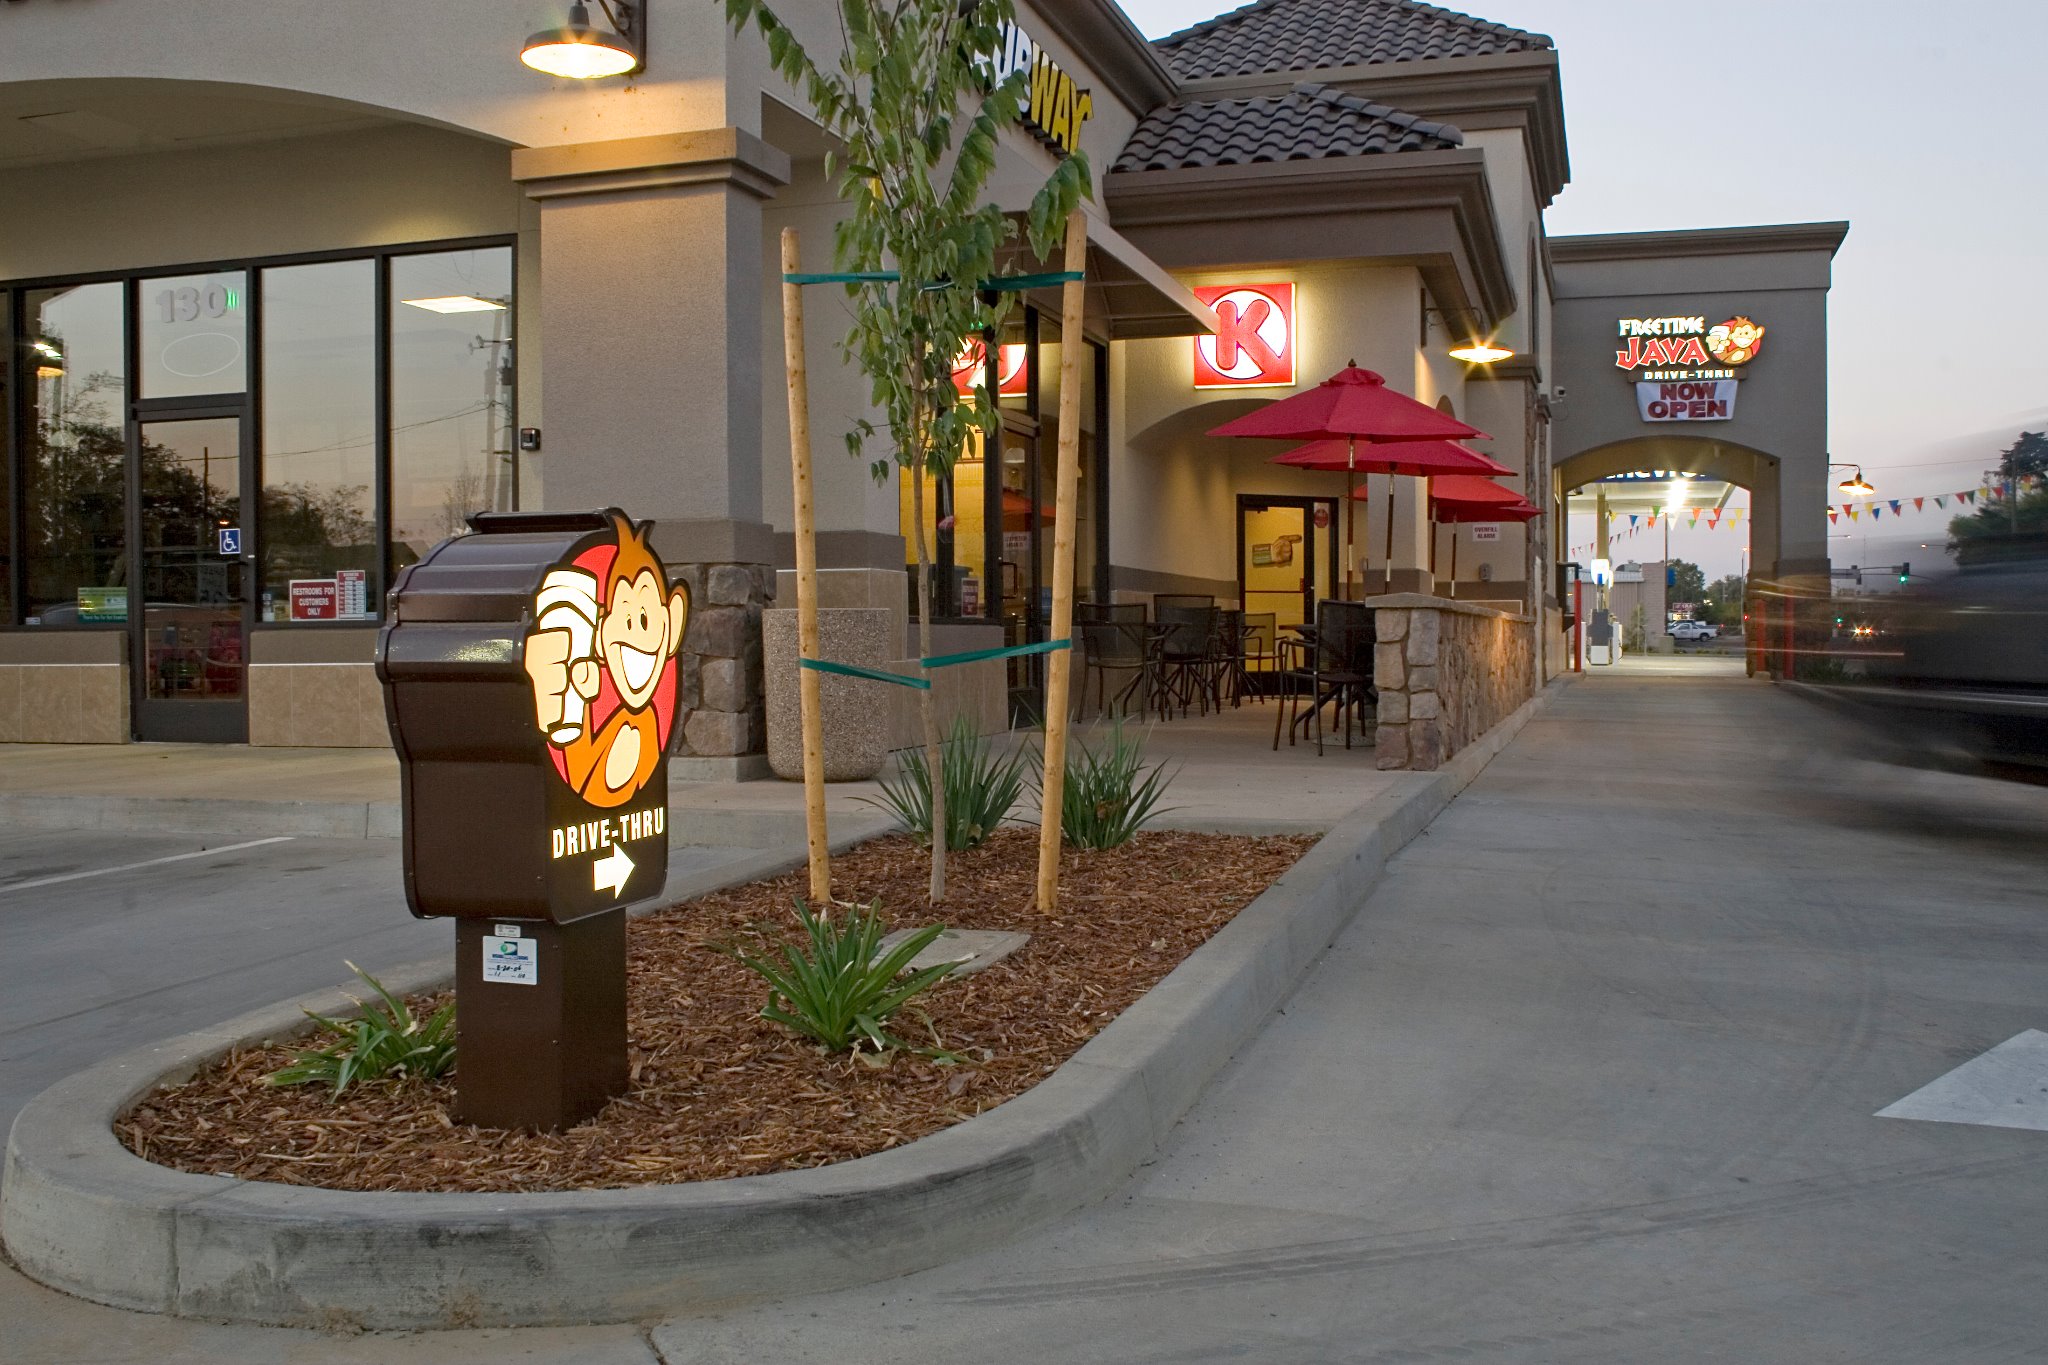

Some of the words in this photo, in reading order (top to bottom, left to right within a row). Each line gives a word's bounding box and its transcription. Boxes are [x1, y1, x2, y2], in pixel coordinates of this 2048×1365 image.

[156, 284, 227, 323] 130
[1618, 316, 1705, 336] FREETIME
[1216, 299, 1281, 372] K
[1615, 336, 1709, 370] JAVA
[1644, 369, 1734, 380] DRIVE-THRU
[1659, 382, 1717, 400] NOW
[1647, 400, 1727, 418] OPEN
[293, 587, 322, 595] RESTROOMS
[324, 587, 335, 595] FOR
[299, 597, 329, 606] CUSTOMERS
[307, 607, 321, 616] ONLY
[552, 806, 664, 859] DRIVE-THRU
